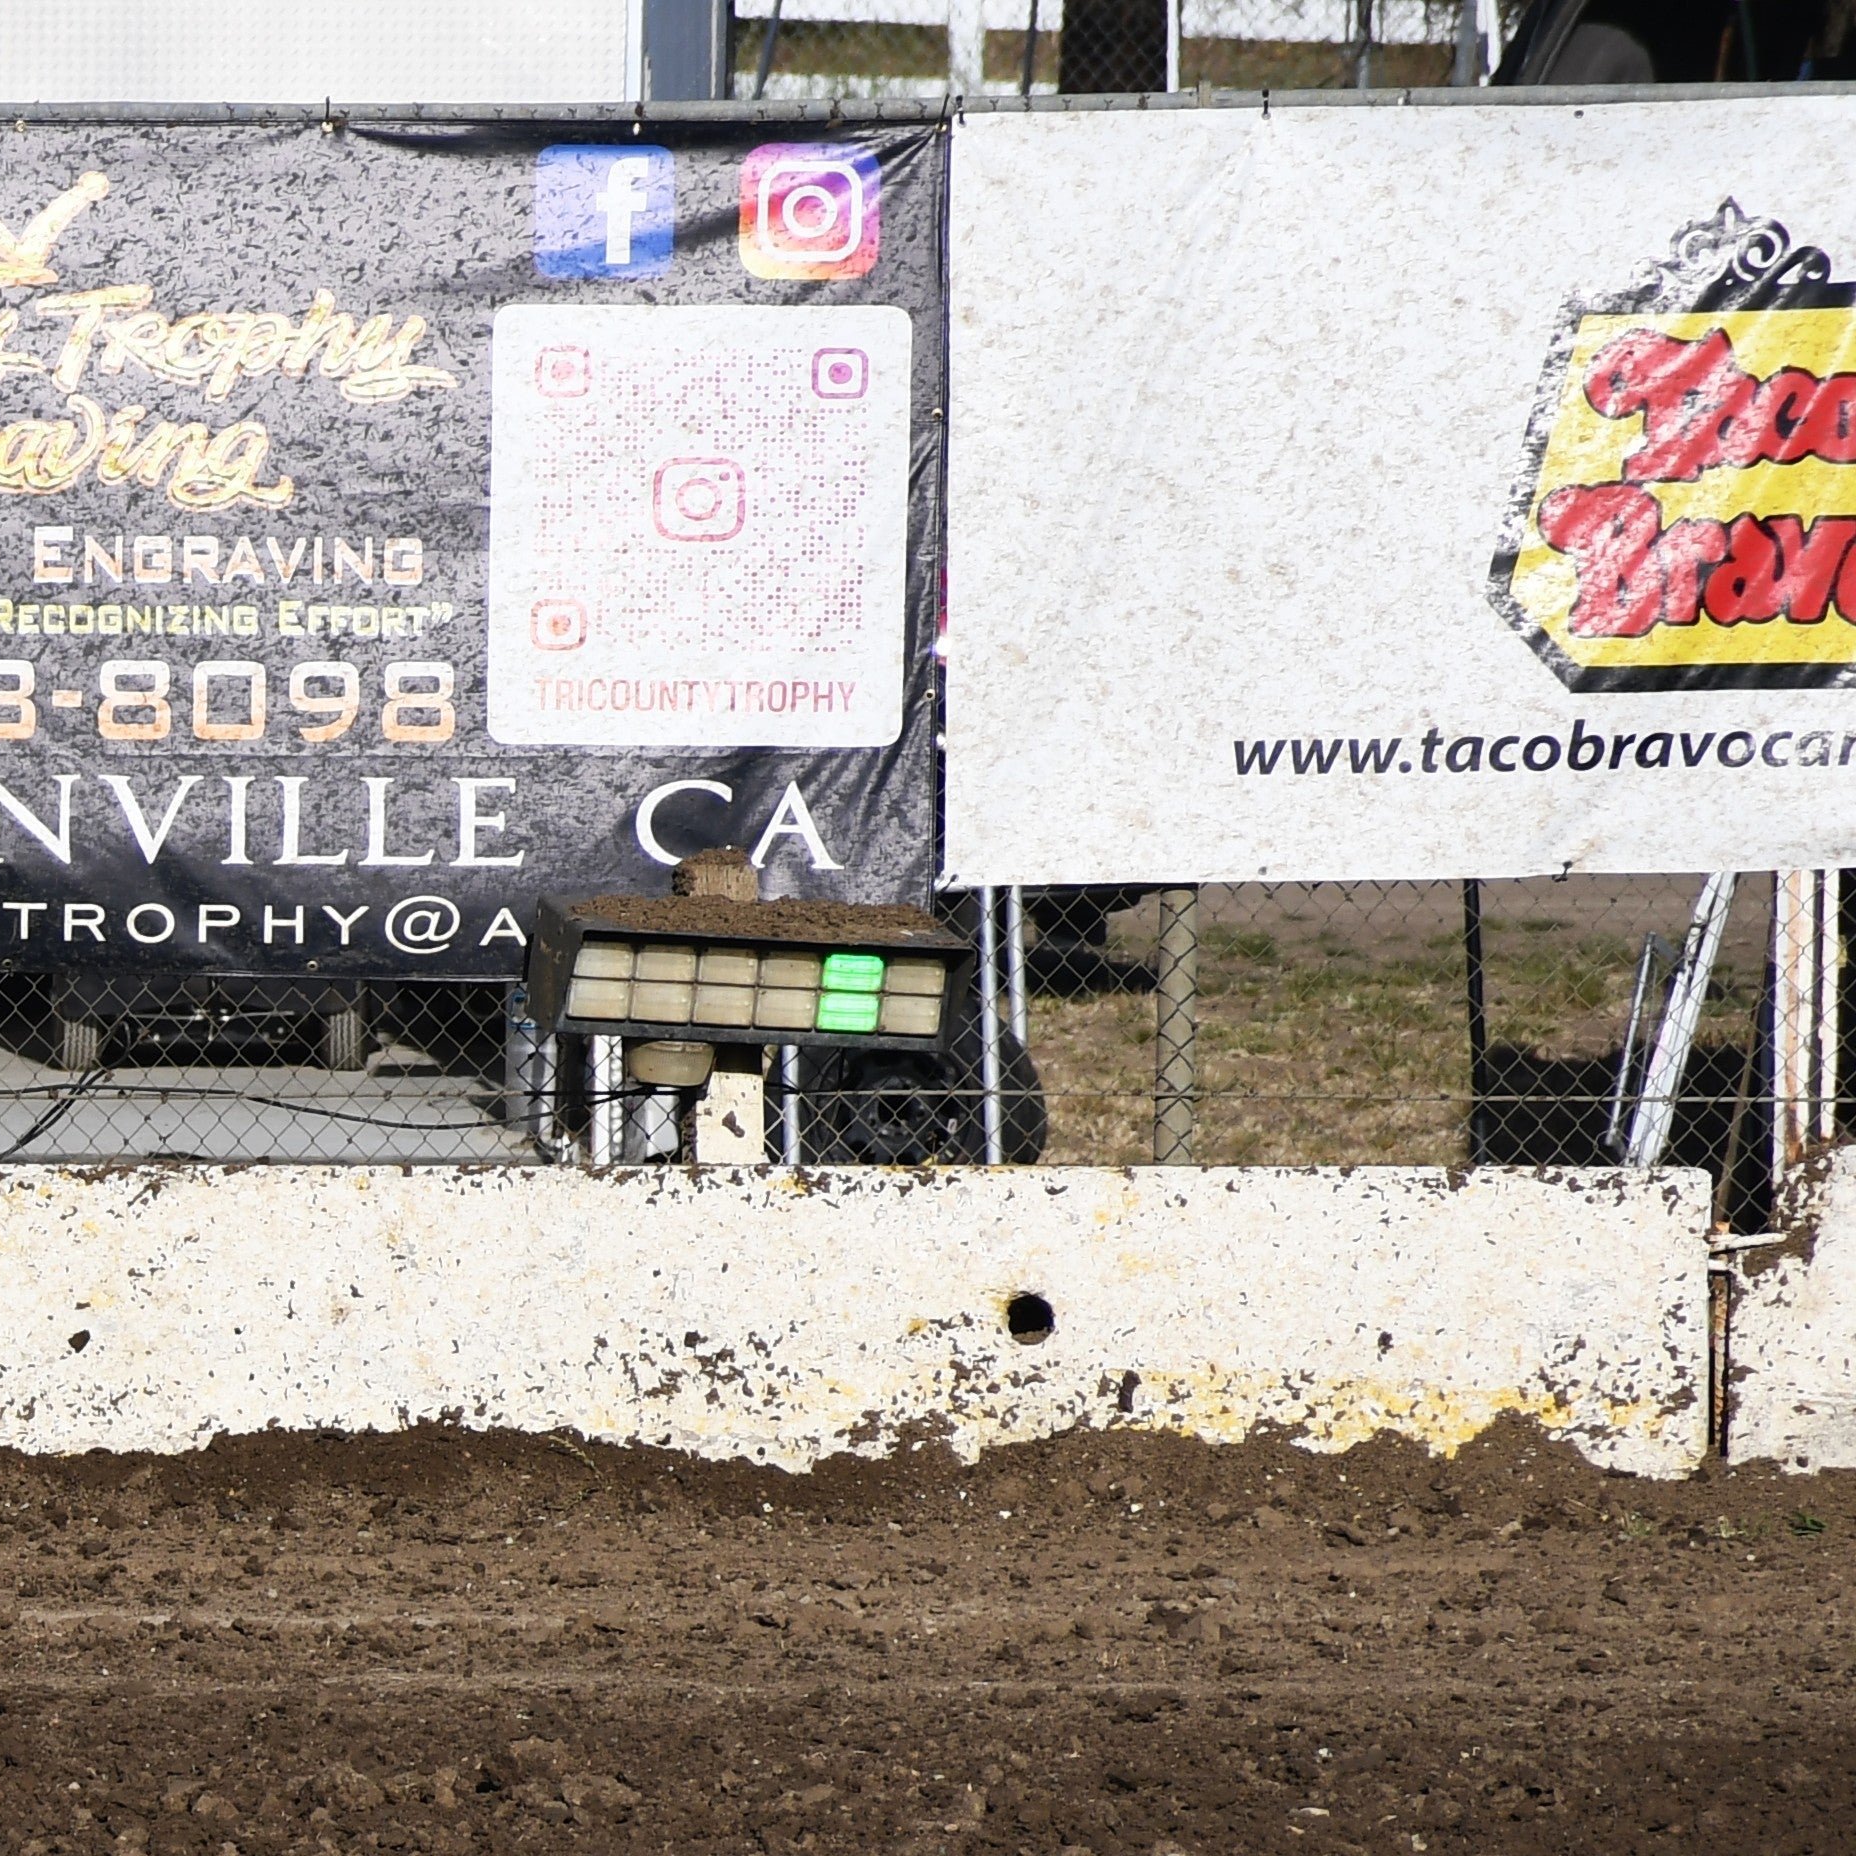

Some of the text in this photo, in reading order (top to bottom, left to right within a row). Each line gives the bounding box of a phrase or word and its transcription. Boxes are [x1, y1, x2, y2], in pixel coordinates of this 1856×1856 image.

[35, 283, 458, 402] Trophy
[32, 525, 425, 587] ENGRAVING
[1538, 480, 1856, 638] Brav
[534, 677, 857, 714] TRICOUNTYTROPHY
[634, 779, 845, 872] CA
